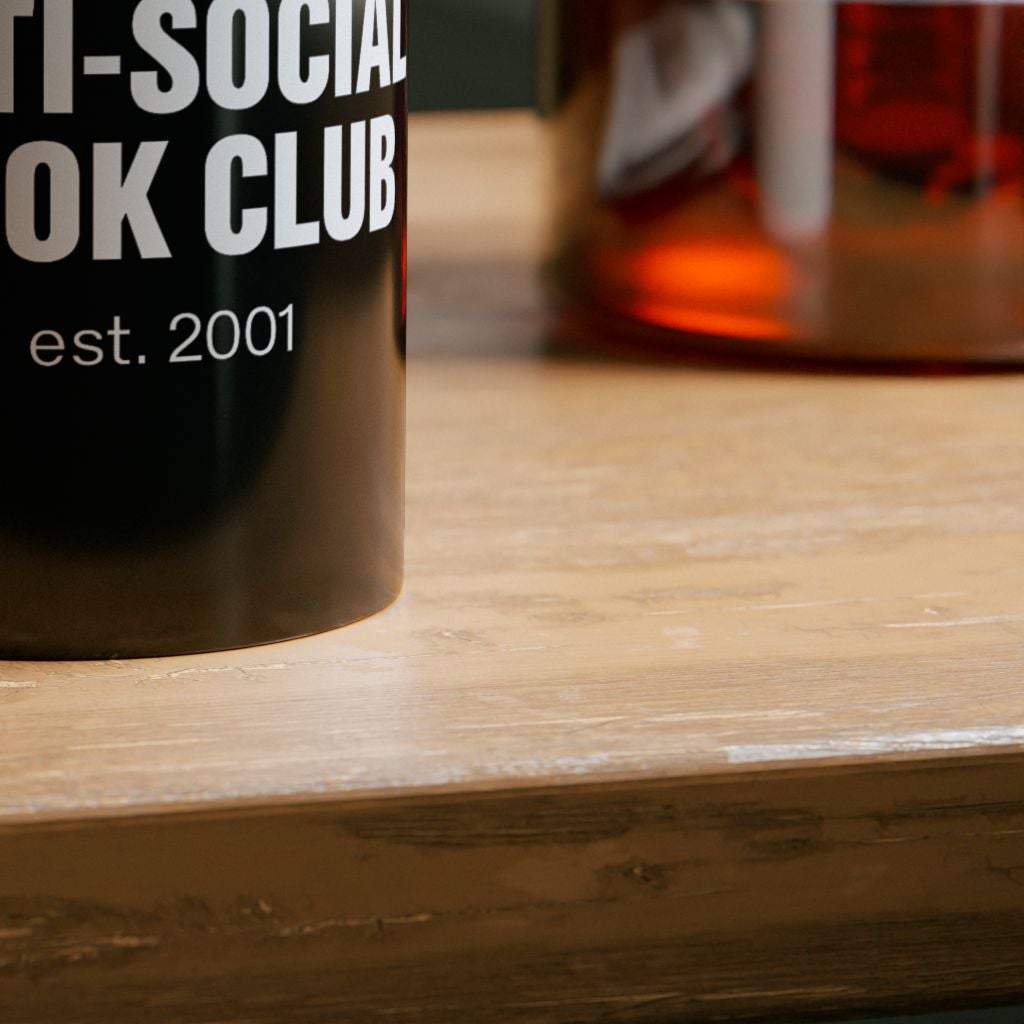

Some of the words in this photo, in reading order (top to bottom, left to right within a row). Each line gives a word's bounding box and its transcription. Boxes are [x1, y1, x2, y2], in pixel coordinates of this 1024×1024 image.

[204, 114, 397, 256] CLUB
[29, 314, 148, 367] est.
[168, 302, 295, 364] 2001
